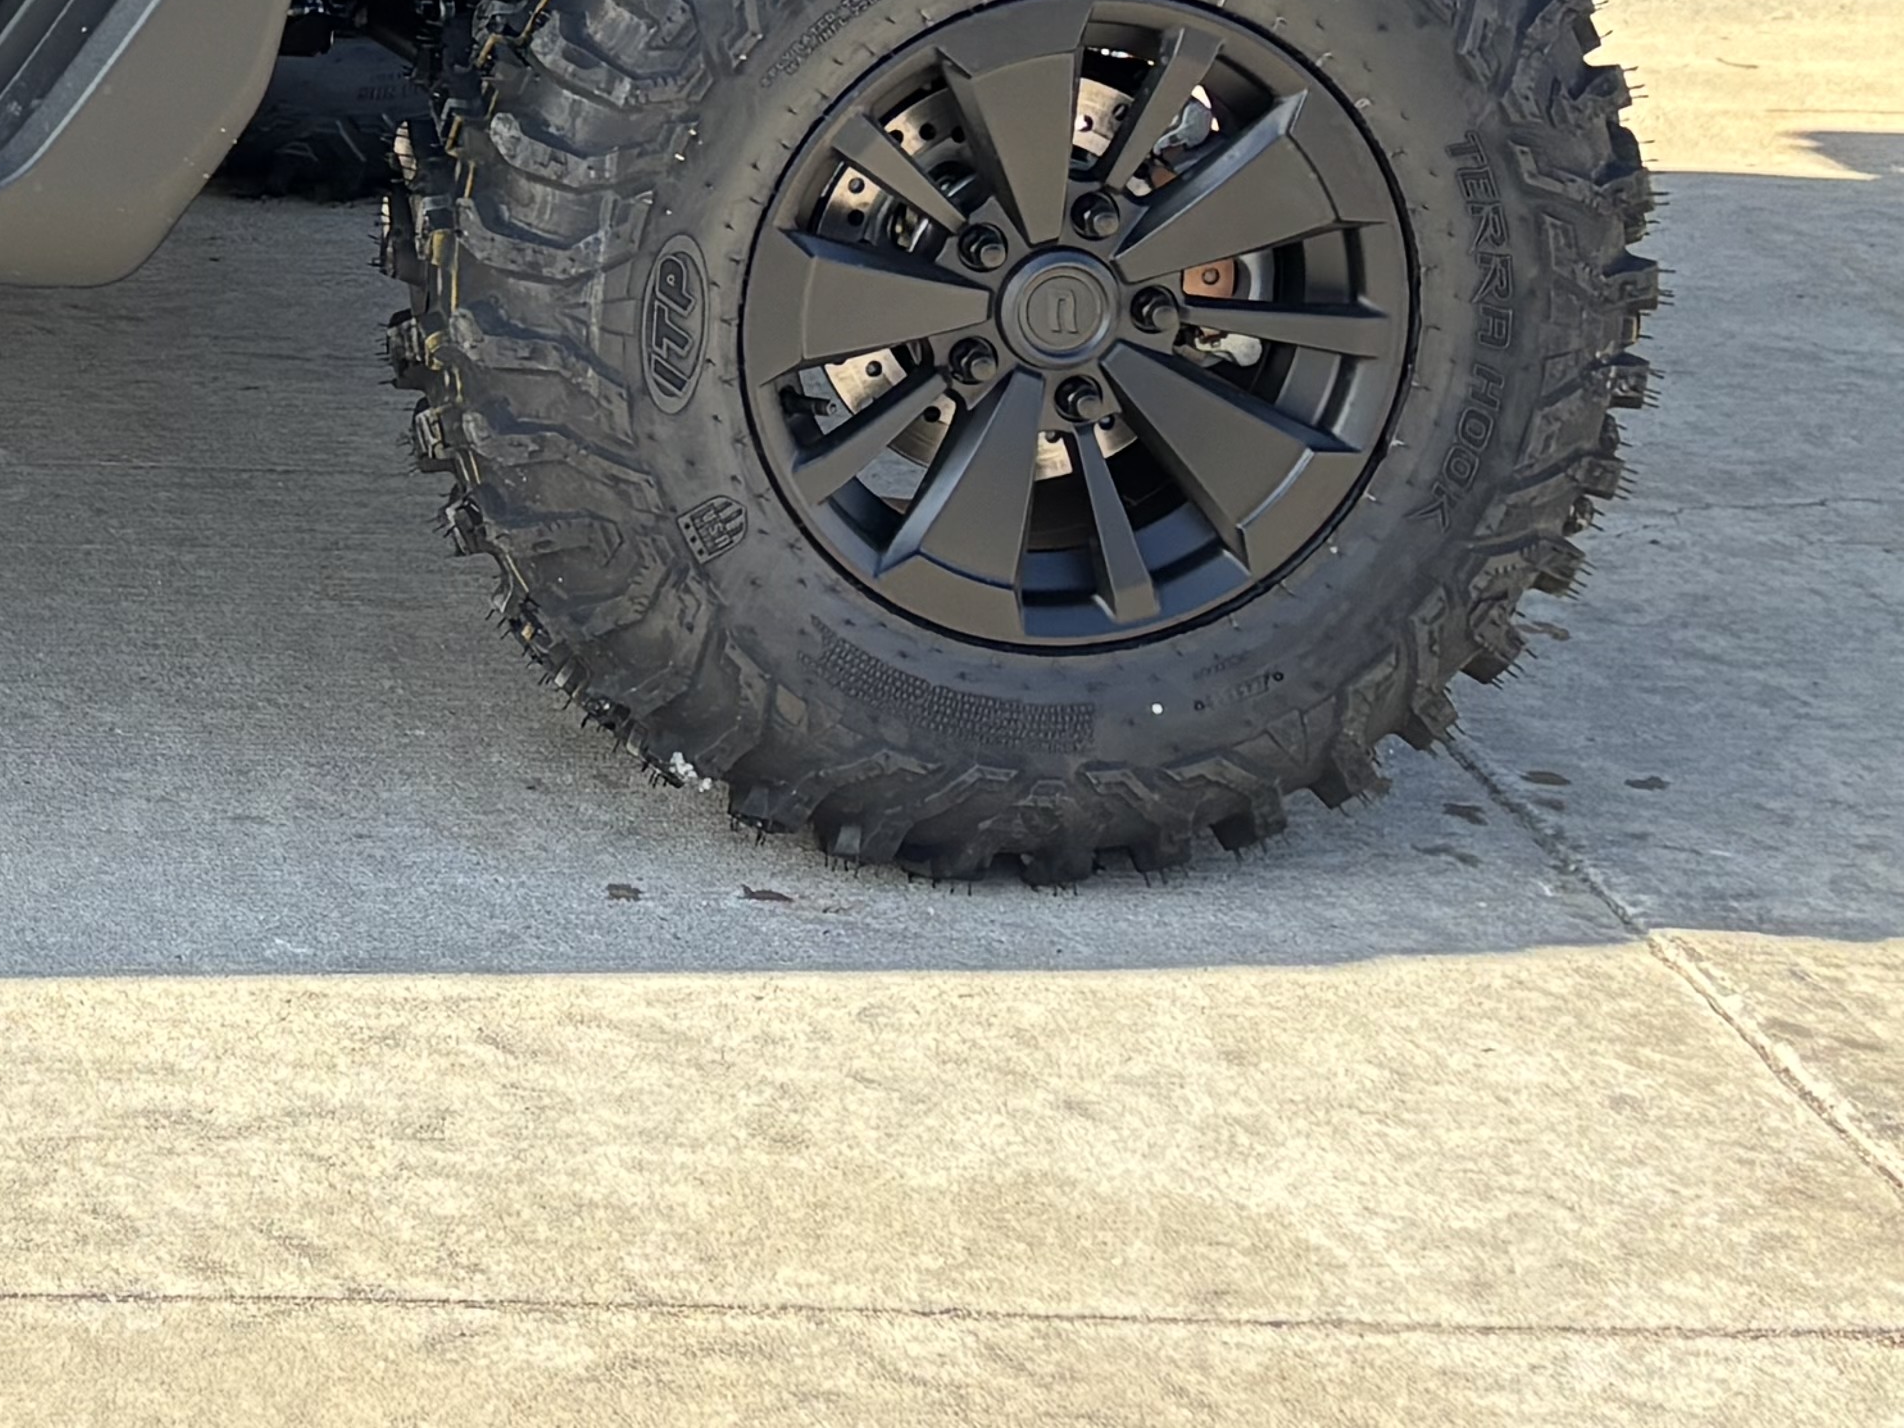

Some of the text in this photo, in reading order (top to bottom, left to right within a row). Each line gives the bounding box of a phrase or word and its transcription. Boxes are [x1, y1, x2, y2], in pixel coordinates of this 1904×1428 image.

[651, 252, 697, 398] ITP
[1400, 129, 1515, 534] TERRA HOOK
